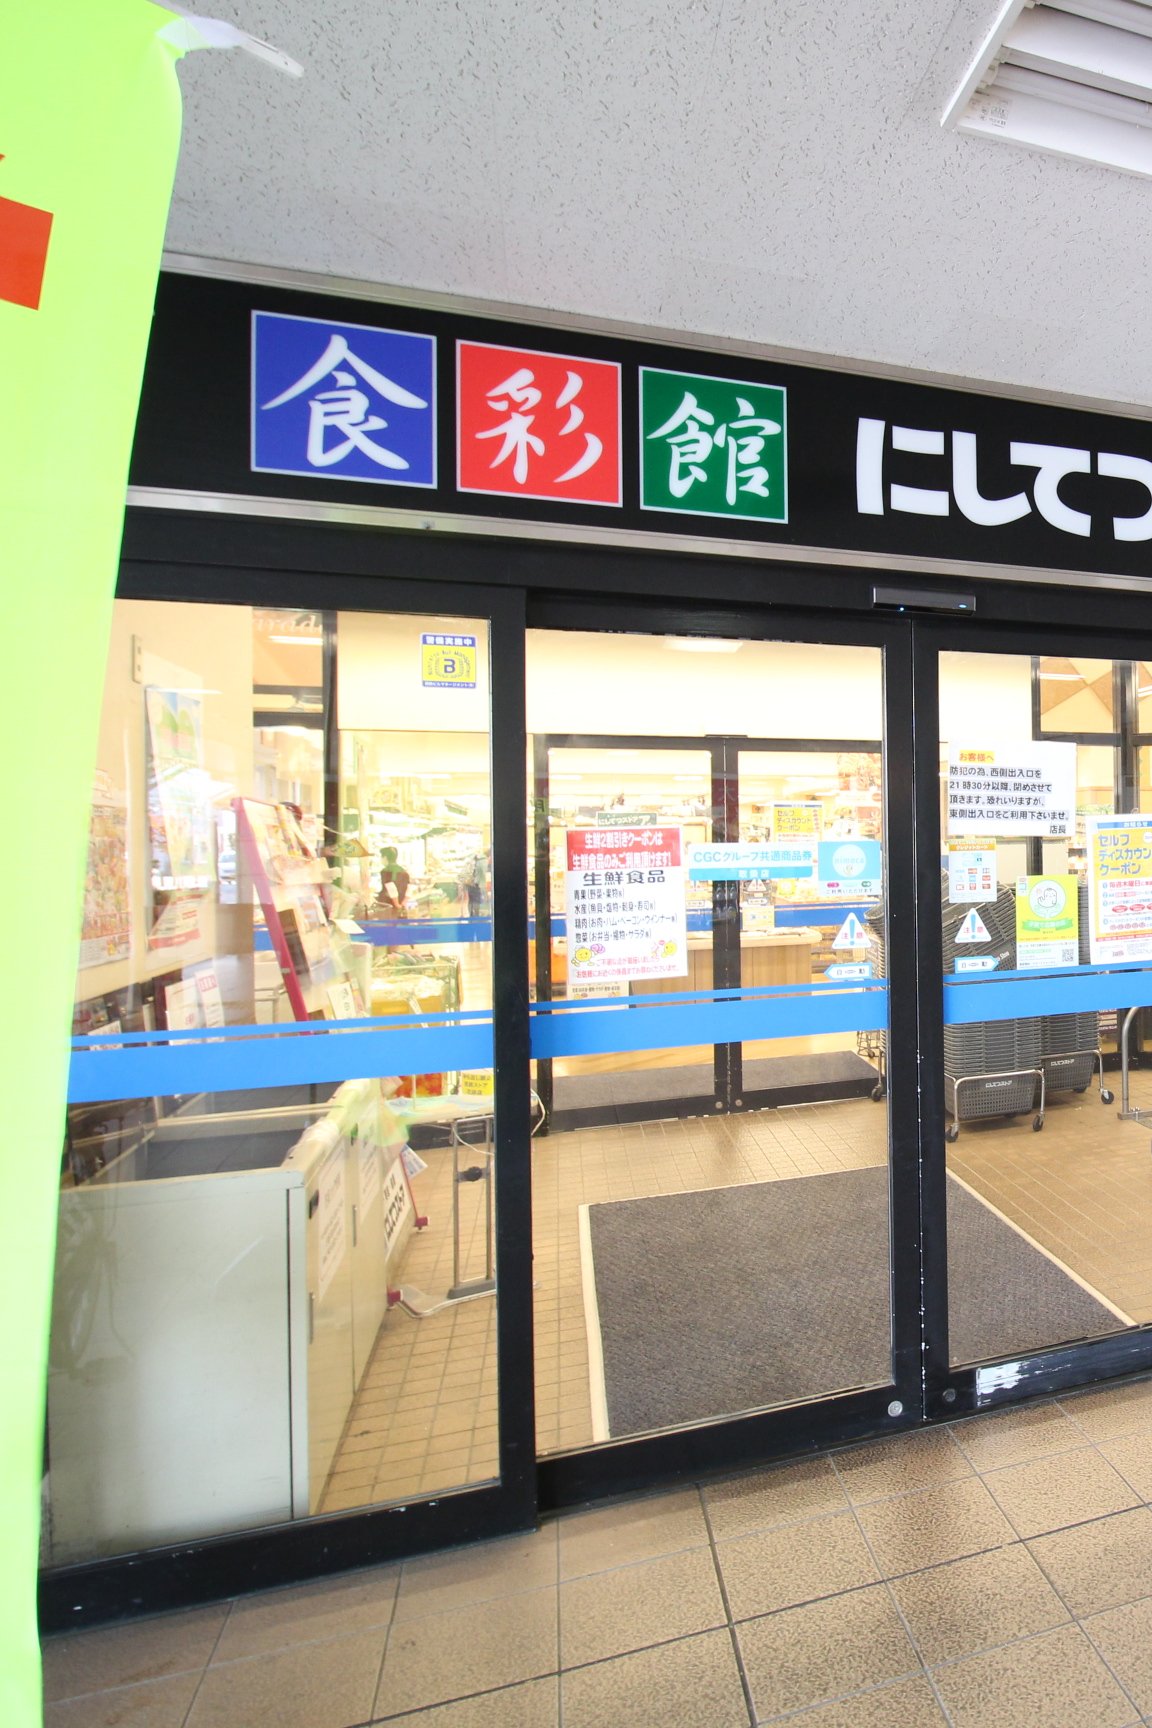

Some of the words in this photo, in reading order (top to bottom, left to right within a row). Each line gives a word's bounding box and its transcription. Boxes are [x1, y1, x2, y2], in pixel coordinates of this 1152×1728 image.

[261, 335, 781, 504] 食彩館
[959, 752, 994, 762] お客様へ
[1049, 825, 1066, 834] 店長
[1098, 834, 1130, 847] セルフ
[1099, 863, 1141, 876] クーポン
[583, 869, 666, 886] 生鮮食品
